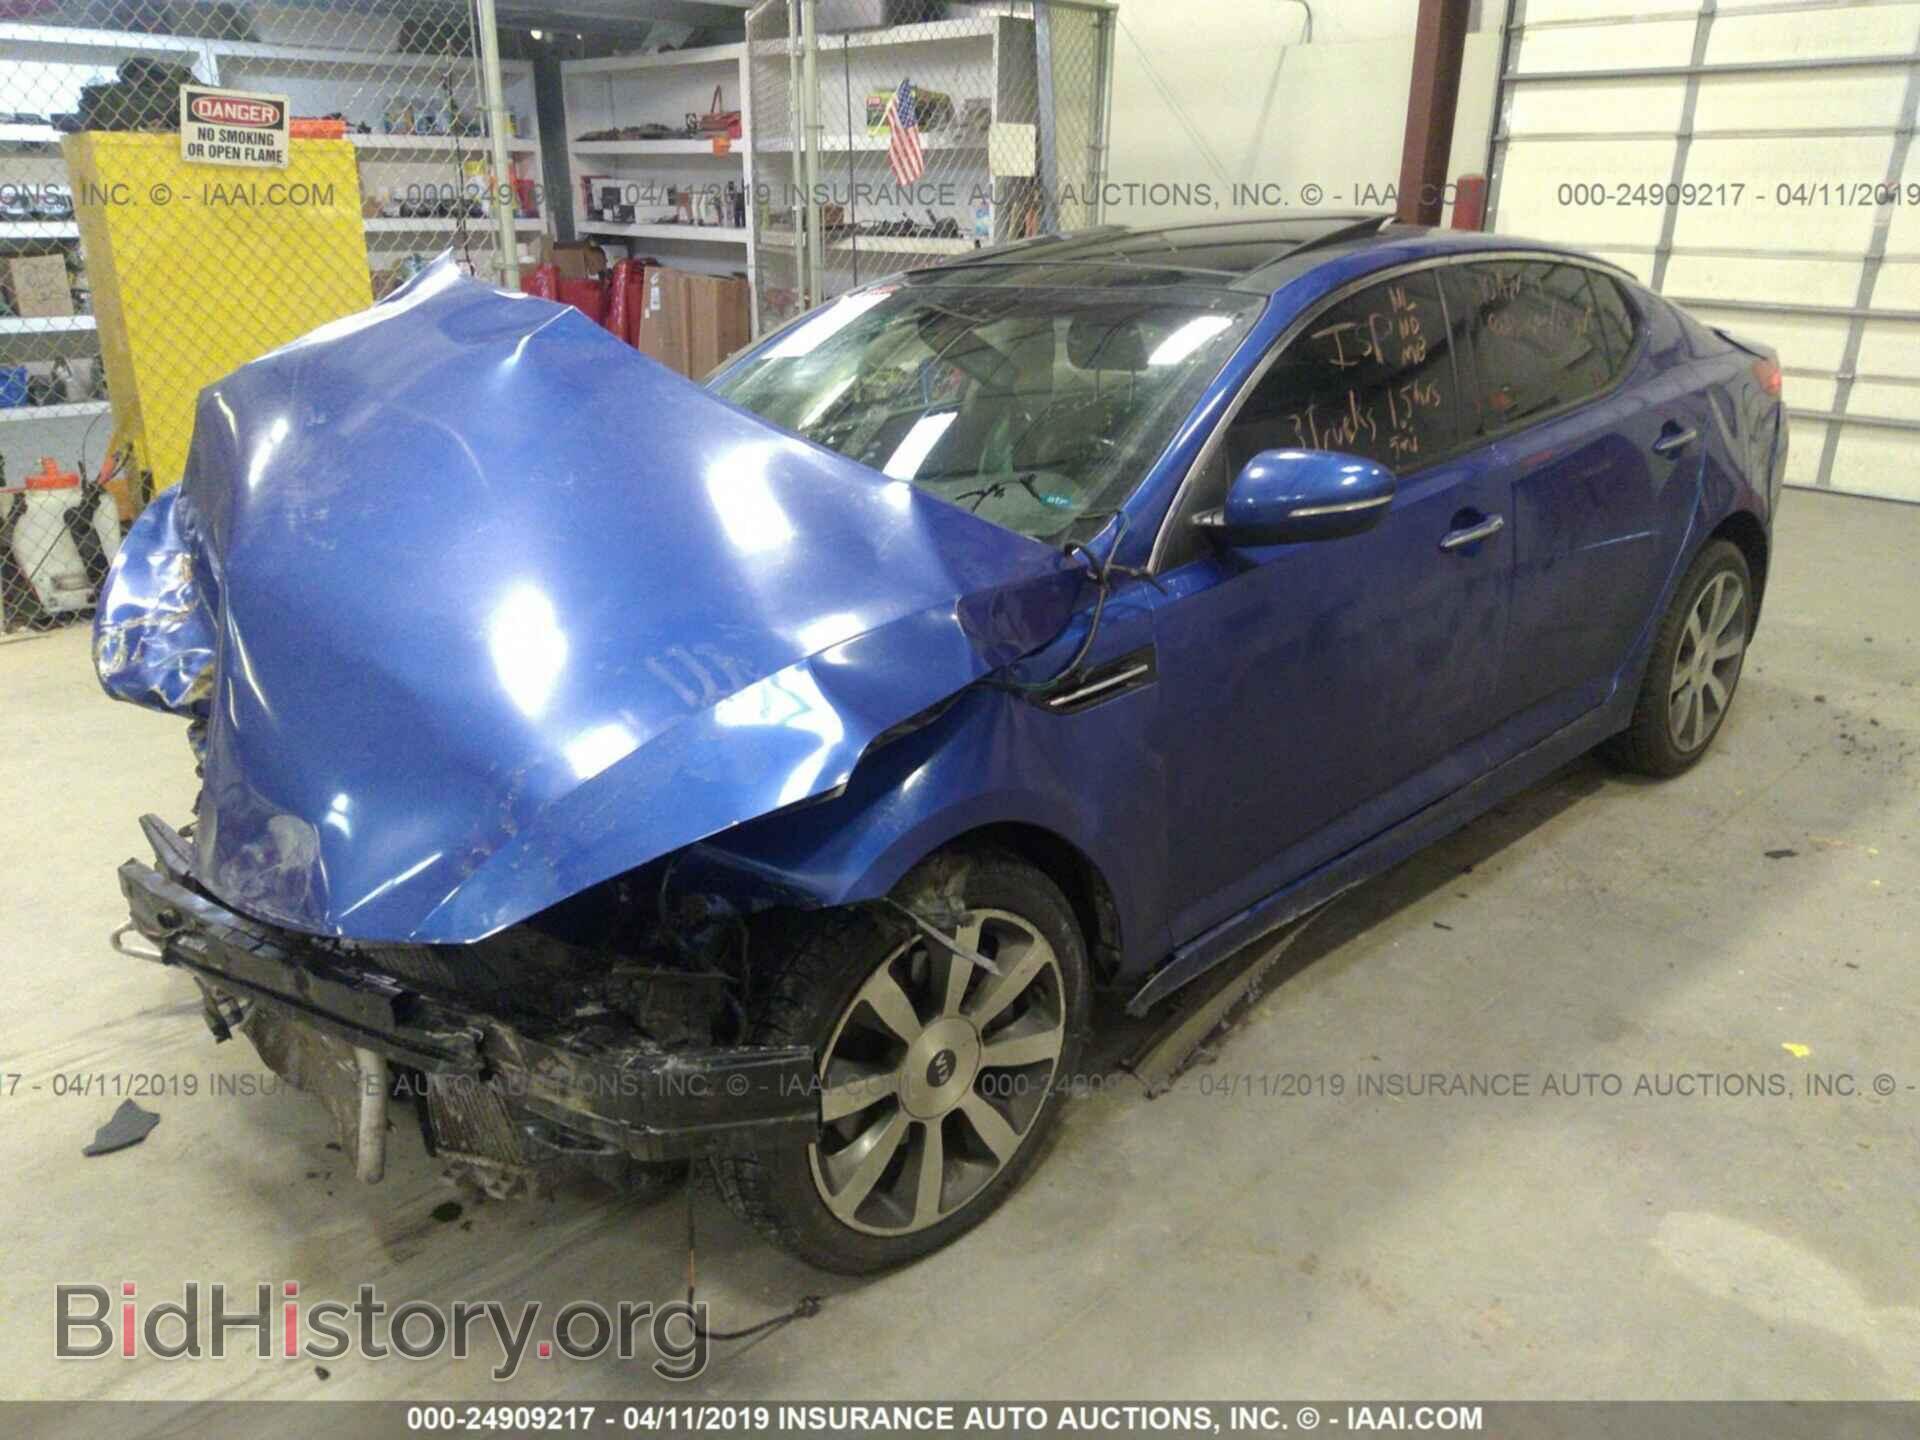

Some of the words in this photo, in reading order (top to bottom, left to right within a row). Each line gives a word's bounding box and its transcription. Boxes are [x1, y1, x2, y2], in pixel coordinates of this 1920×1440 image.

[199, 100, 274, 122] DANGER
[197, 126, 215, 142] NO
[218, 129, 274, 146] SMOKING
[187, 142, 204, 157] OR
[208, 145, 241, 160] OPEN
[244, 147, 283, 164] FLAME
